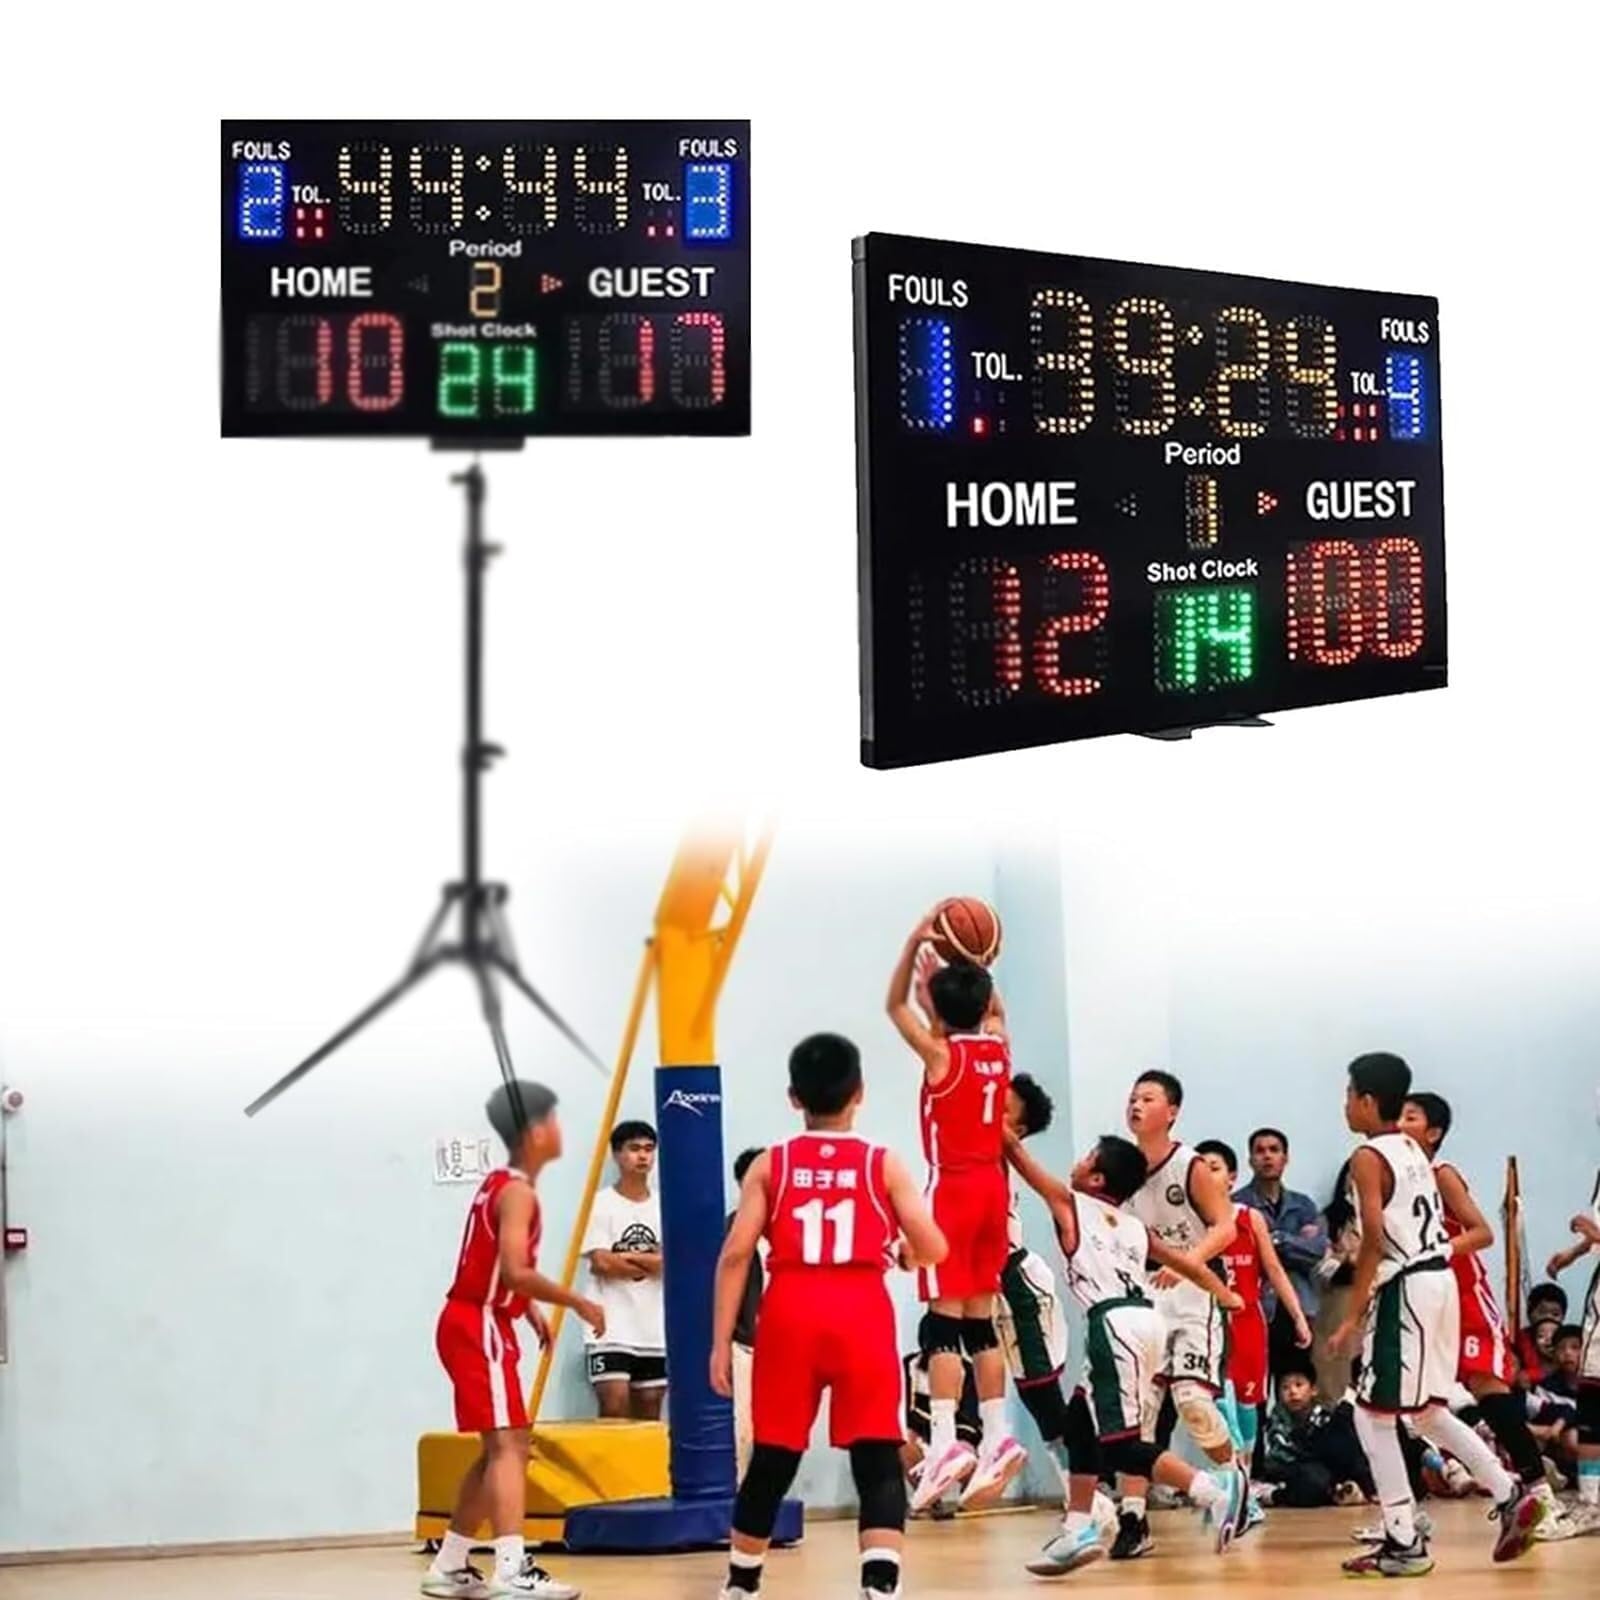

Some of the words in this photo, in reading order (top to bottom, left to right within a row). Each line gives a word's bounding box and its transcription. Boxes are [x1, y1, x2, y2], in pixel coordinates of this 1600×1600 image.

[231, 140, 291, 161] FOULS
[679, 138, 738, 158] FOULS
[242, 165, 283, 237] 2
[291, 185, 331, 204] TOL.
[338, 146, 629, 230] 44:44
[642, 182, 682, 202] TOL.
[691, 165, 727, 236] 3
[449, 240, 523, 258] Period
[270, 267, 373, 297] HOME
[470, 262, 501, 317] 2
[588, 266, 716, 297] GUEST
[888, 273, 969, 308] FOULS
[431, 322, 477, 338] Shot
[480, 322, 537, 338] Clock
[1380, 317, 1430, 343] FOULS
[316, 313, 404, 410] 10
[638, 312, 725, 402] 17
[970, 351, 1023, 381] TOL.
[1031, 287, 1338, 439] 39:24
[438, 343, 536, 416] 24
[1350, 371, 1386, 397] TOL.
[1385, 354, 1420, 437] 4
[1164, 441, 1242, 466] Period
[946, 481, 1078, 528] HOME
[1306, 480, 1416, 520] GUEST
[1147, 562, 1198, 583] Shot
[1201, 558, 1259, 580] Clock
[1287, 537, 1424, 665] 100
[994, 552, 1109, 697] 12
[1175, 590, 1252, 685] 14
[982, 1081, 998, 1125] 1
[792, 1197, 857, 1265] 11
[1464, 1335, 1480, 1358] 6
